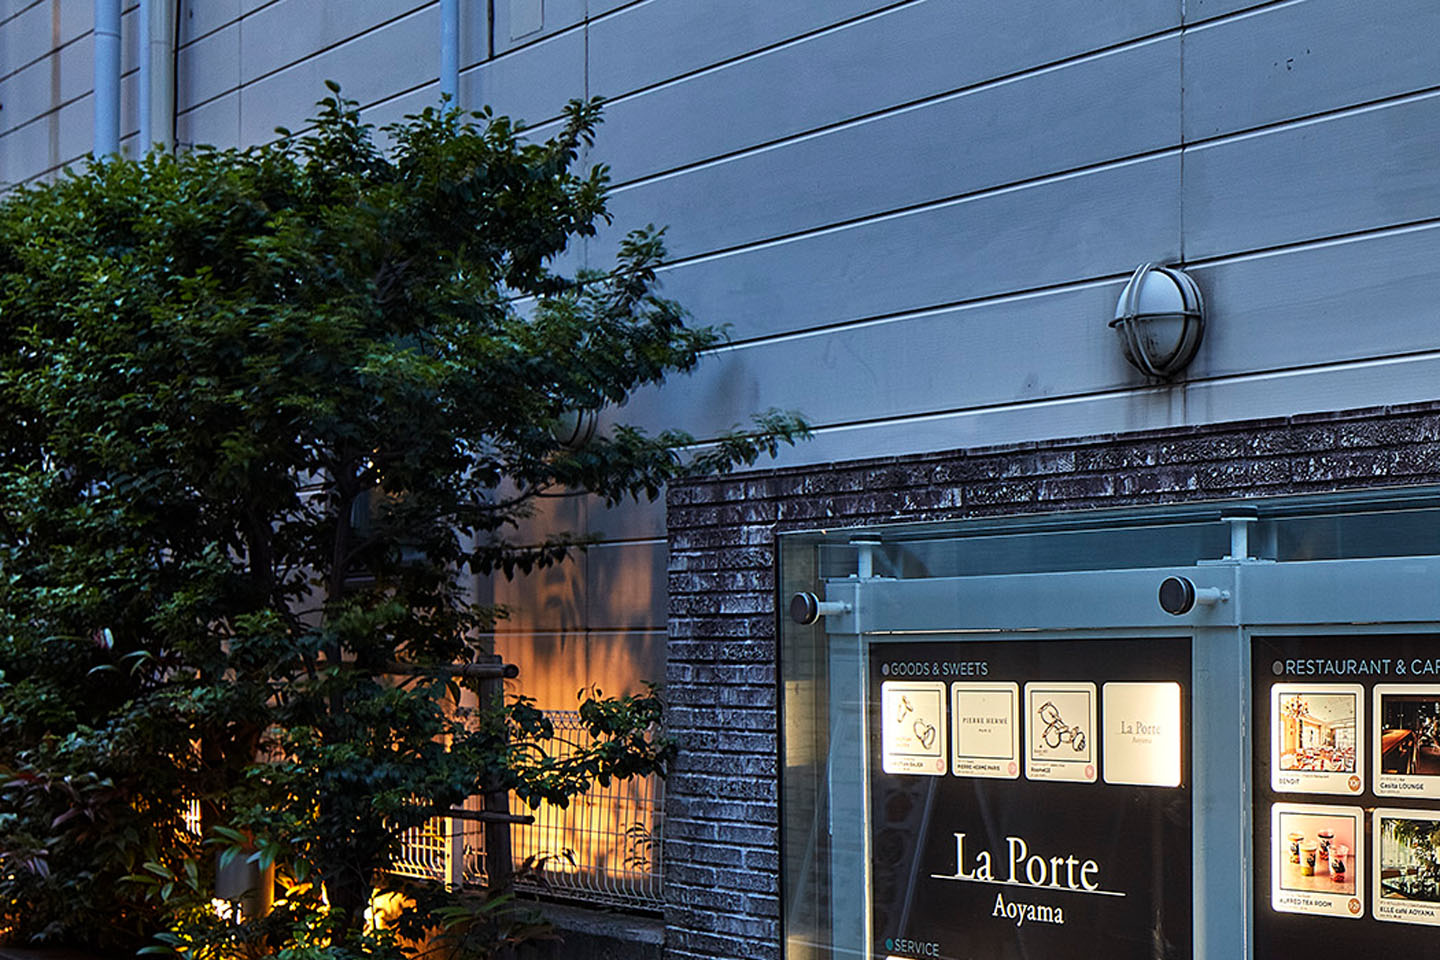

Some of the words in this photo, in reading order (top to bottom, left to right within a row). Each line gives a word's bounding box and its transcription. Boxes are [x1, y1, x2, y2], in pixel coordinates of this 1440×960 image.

[891, 662, 930, 675] GOODS
[932, 663, 940, 675] &
[942, 662, 989, 675] SWEETS
[1285, 659, 1392, 675] RESTAURANT
[1395, 659, 1407, 675] &
[1399, 783, 1424, 791] LOUNGE
[954, 832, 994, 882] La
[1006, 836, 1099, 891] Porte
[992, 893, 1065, 927] Aoyama
[894, 938, 940, 957] SERVICE
